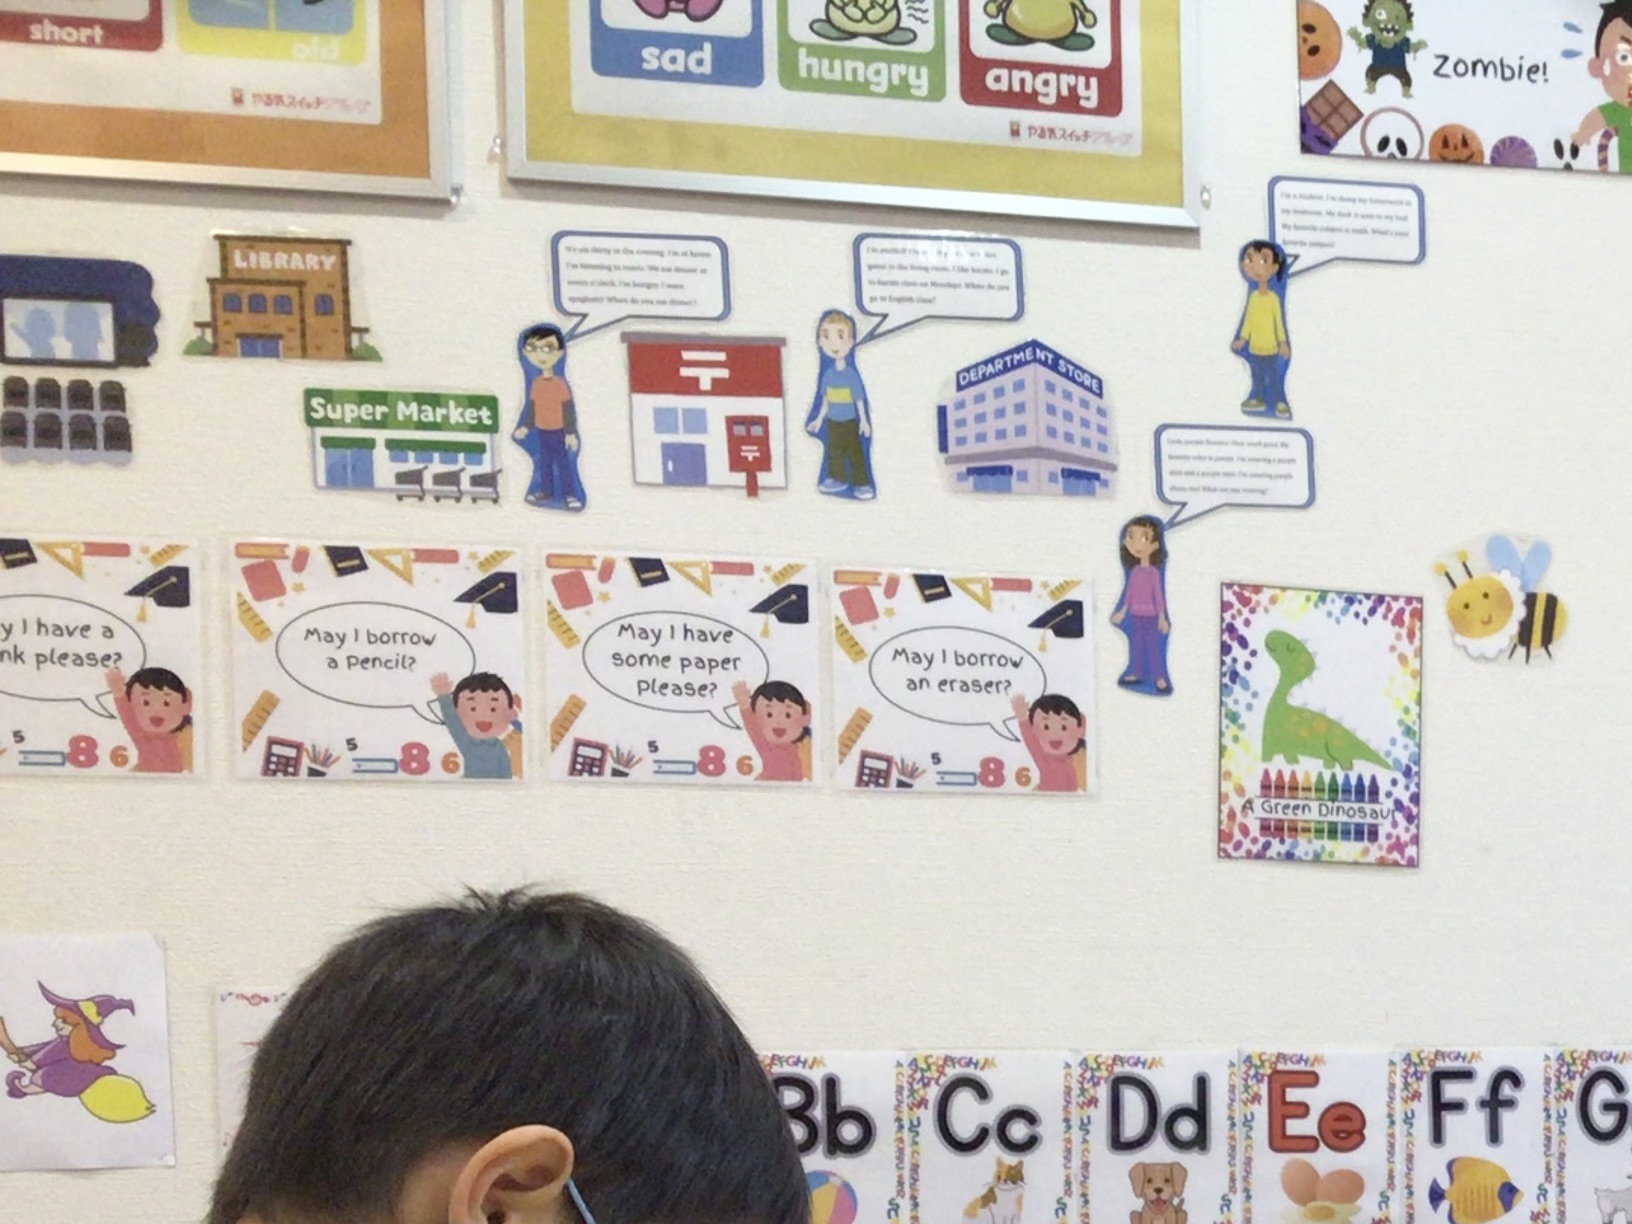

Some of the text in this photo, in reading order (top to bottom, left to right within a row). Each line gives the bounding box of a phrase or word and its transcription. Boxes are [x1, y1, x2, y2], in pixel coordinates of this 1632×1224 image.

[29, 17, 104, 46] short
[291, 37, 339, 62] old
[641, 43, 712, 75] sad
[799, 47, 929, 97] hungry
[1433, 53, 1551, 84] Zombie!
[984, 64, 1099, 107] angry
[233, 248, 336, 273] LIBRARY
[958, 346, 1101, 394] DEPARTMENT STORE
[309, 397, 493, 426] Super Market
[36, 617, 91, 640] have
[100, 625, 115, 640] a
[303, 626, 438, 650] May I borrow
[617, 622, 734, 647] May I have
[35, 649, 123, 674] please?
[326, 656, 340, 671] a
[610, 650, 742, 678] some paper
[891, 647, 1024, 670] May I borrow
[906, 675, 1011, 696] an eraser?
[12, 729, 26, 745] 5
[344, 737, 359, 752] 5
[646, 740, 660, 755] 5
[66, 734, 99, 769] 8
[109, 744, 130, 768] 6
[399, 741, 431, 776] 8
[441, 752, 461, 774] 6
[697, 745, 727, 777] 8
[930, 752, 943, 767] 5
[735, 755, 754, 776] 6
[977, 756, 1006, 788] 8
[1014, 765, 1032, 787] 6
[1240, 799, 1398, 821] A Green Dinosaur
[933, 1072, 1043, 1158] Cc
[1106, 1071, 1213, 1156] Dd
[1267, 1069, 1367, 1153] Ee
[1428, 1065, 1525, 1149] Ff
